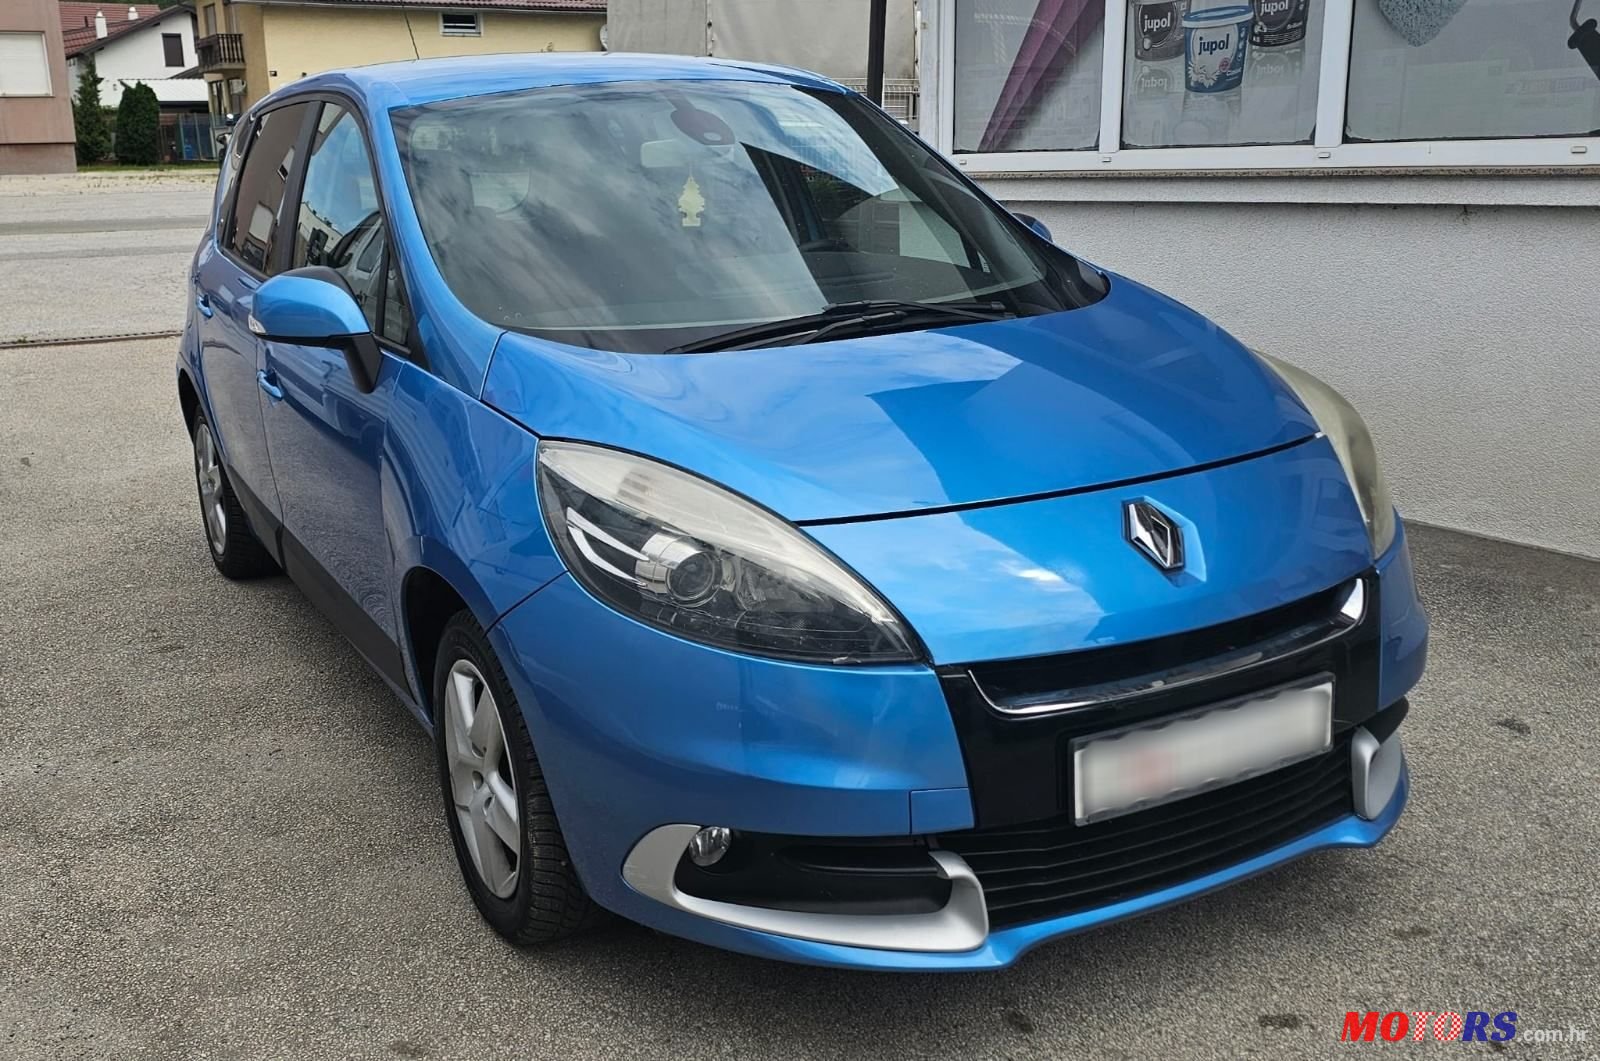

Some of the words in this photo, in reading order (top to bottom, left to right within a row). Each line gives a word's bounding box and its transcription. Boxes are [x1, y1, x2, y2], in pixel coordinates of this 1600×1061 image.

[1261, 0, 1289, 16] jupol
[1143, 11, 1171, 32] jupol
[1198, 33, 1230, 55] jupol
